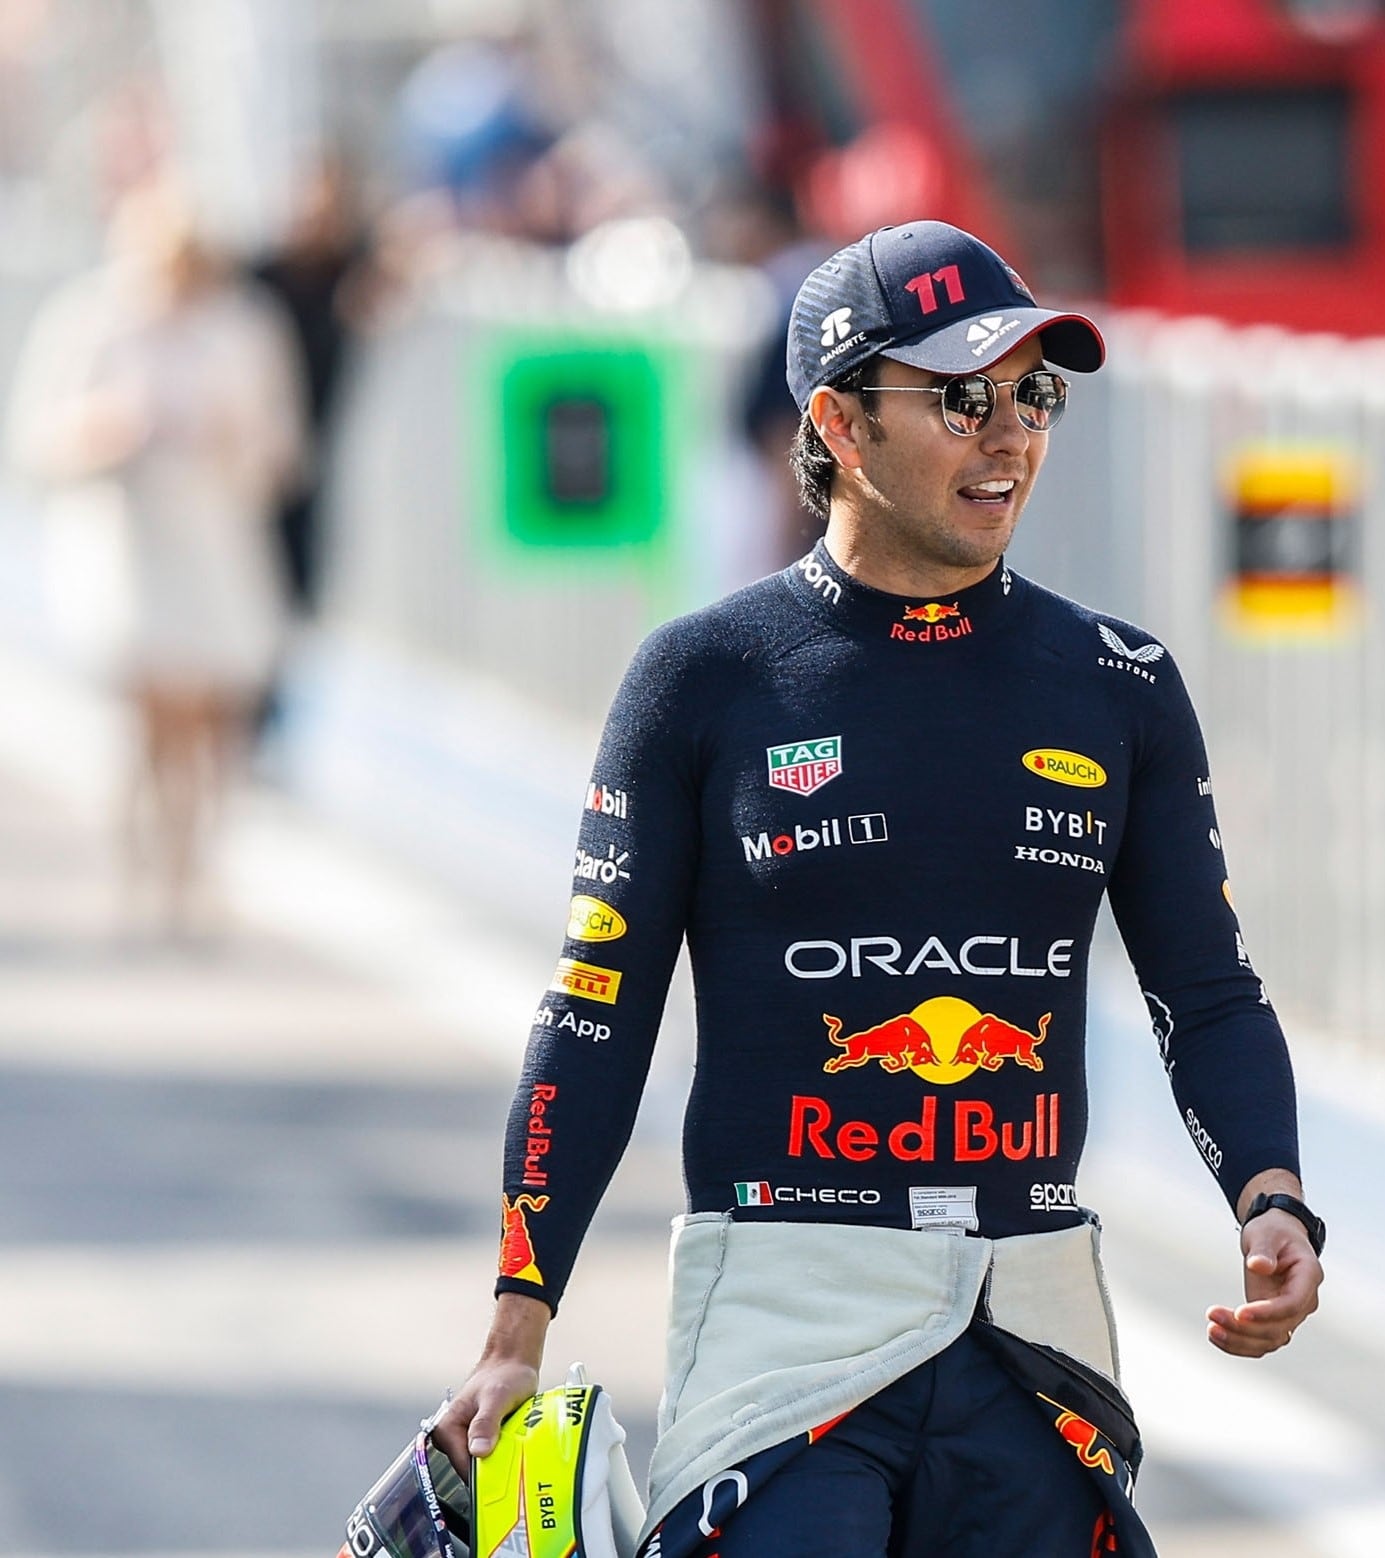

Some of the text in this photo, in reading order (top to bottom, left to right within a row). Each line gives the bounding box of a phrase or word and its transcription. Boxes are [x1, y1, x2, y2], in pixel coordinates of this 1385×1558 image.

[904, 264, 965, 316] 11
[820, 331, 867, 366] BANORTE
[798, 552, 842, 605] oom
[890, 617, 973, 642] Red Bull
[1098, 656, 1157, 685] CASTORE
[772, 741, 835, 766] TAG
[1046, 757, 1099, 782] RAUCH
[772, 760, 838, 794] HEUER
[742, 819, 842, 862] Mobil
[1025, 806, 1107, 845] BYBIT
[1014, 846, 1105, 874] HONDA
[784, 935, 1074, 979] ORACLE
[558, 1011, 611, 1042] App
[522, 1084, 557, 1186] Red Bull
[788, 1093, 1059, 1161] Red Bull
[1186, 1107, 1223, 1172] sparco
[775, 1186, 881, 1204] CHECO
[1030, 1181, 1078, 1212] spar
[538, 1482, 556, 1530] BYBIT
